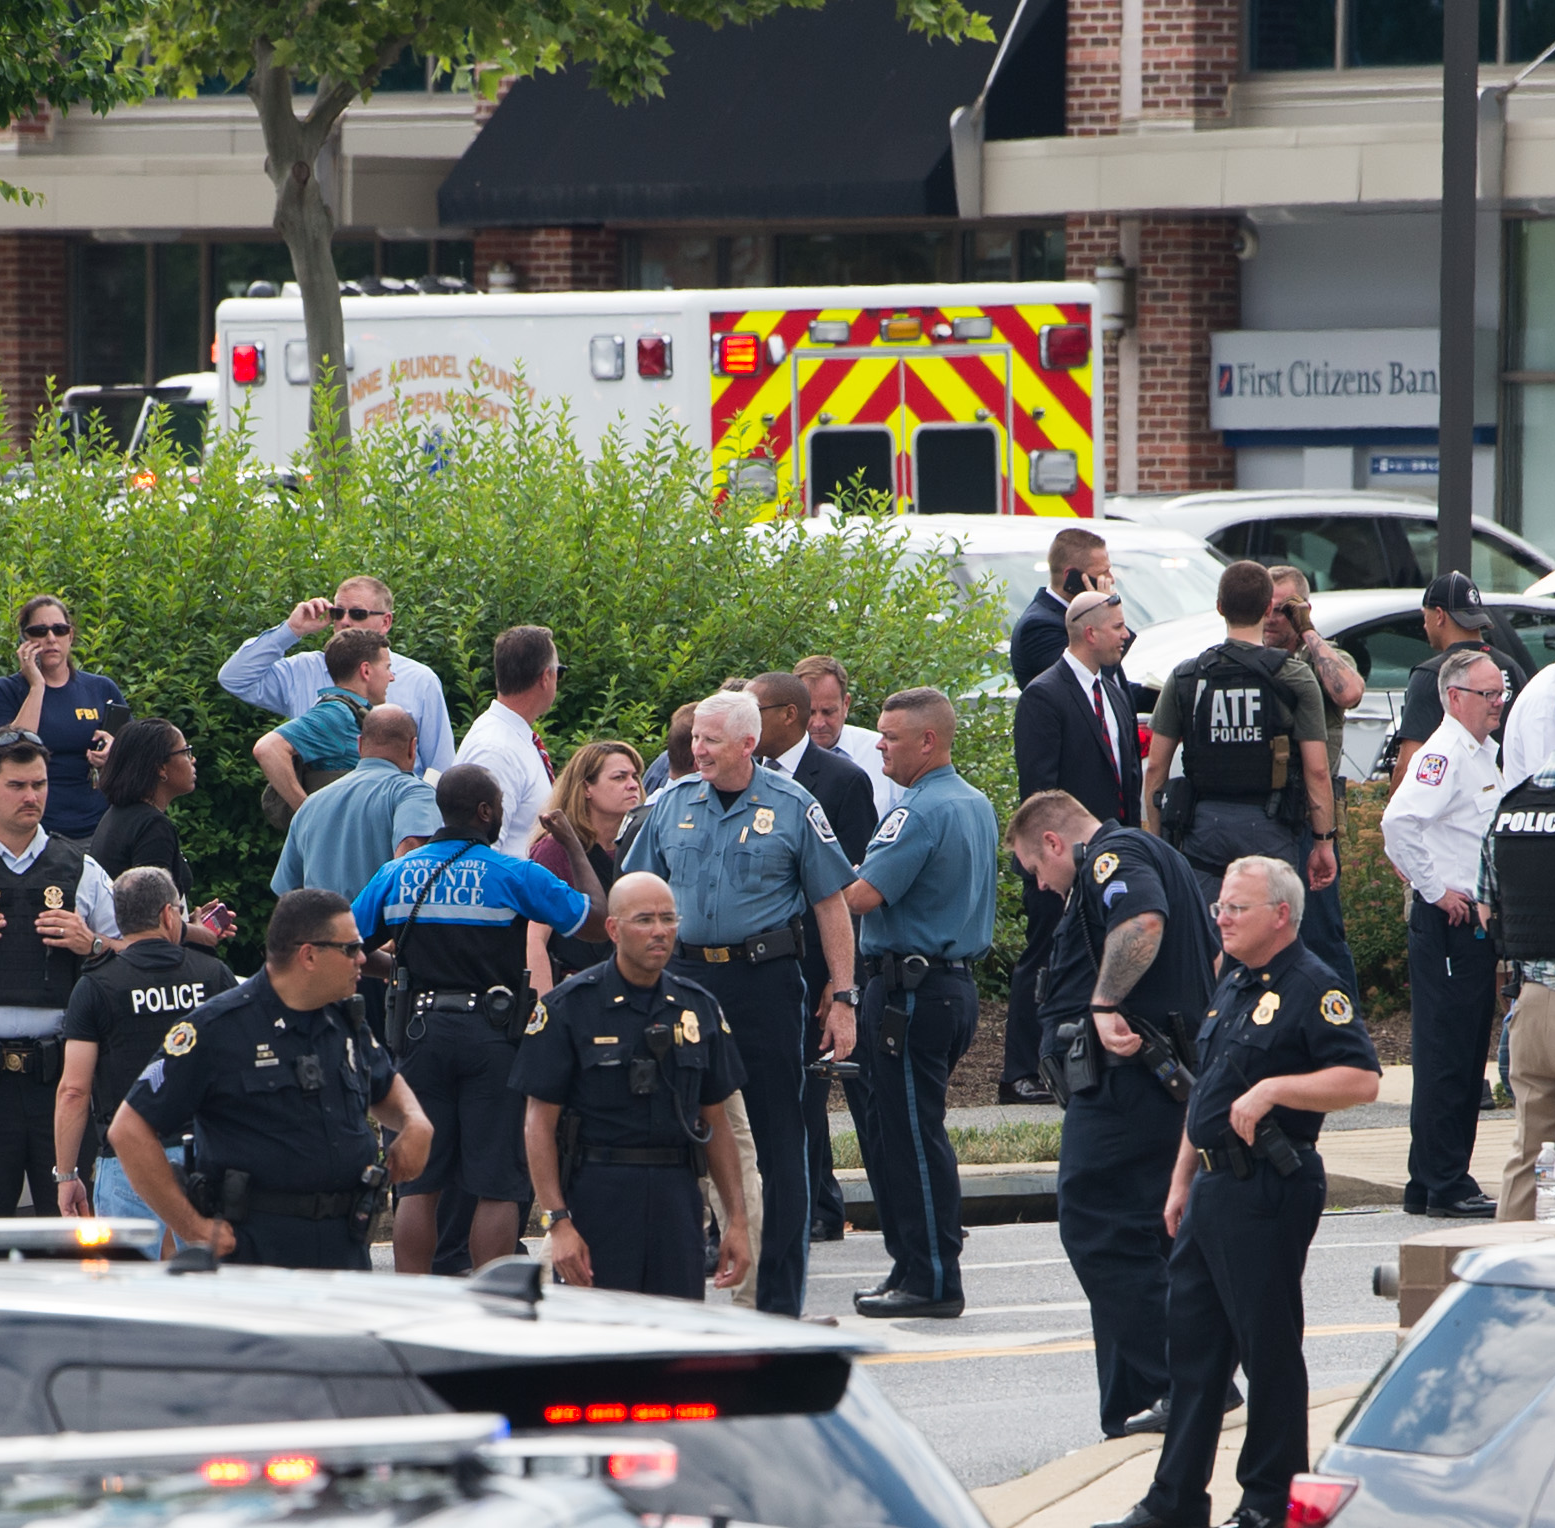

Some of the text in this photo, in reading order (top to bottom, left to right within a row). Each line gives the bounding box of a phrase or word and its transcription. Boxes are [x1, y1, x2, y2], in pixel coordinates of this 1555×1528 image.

[350, 369, 382, 406] NNE
[1237, 360, 1439, 397] First Citizens Ban
[75, 708, 99, 720] FBI
[1210, 688, 1261, 727] ATF
[1210, 727, 1262, 742] POLICE
[434, 860, 488, 871] AUNDEL
[400, 868, 486, 888] COUNTY
[399, 885, 484, 907] POLICE
[131, 983, 205, 1014] POLICE
